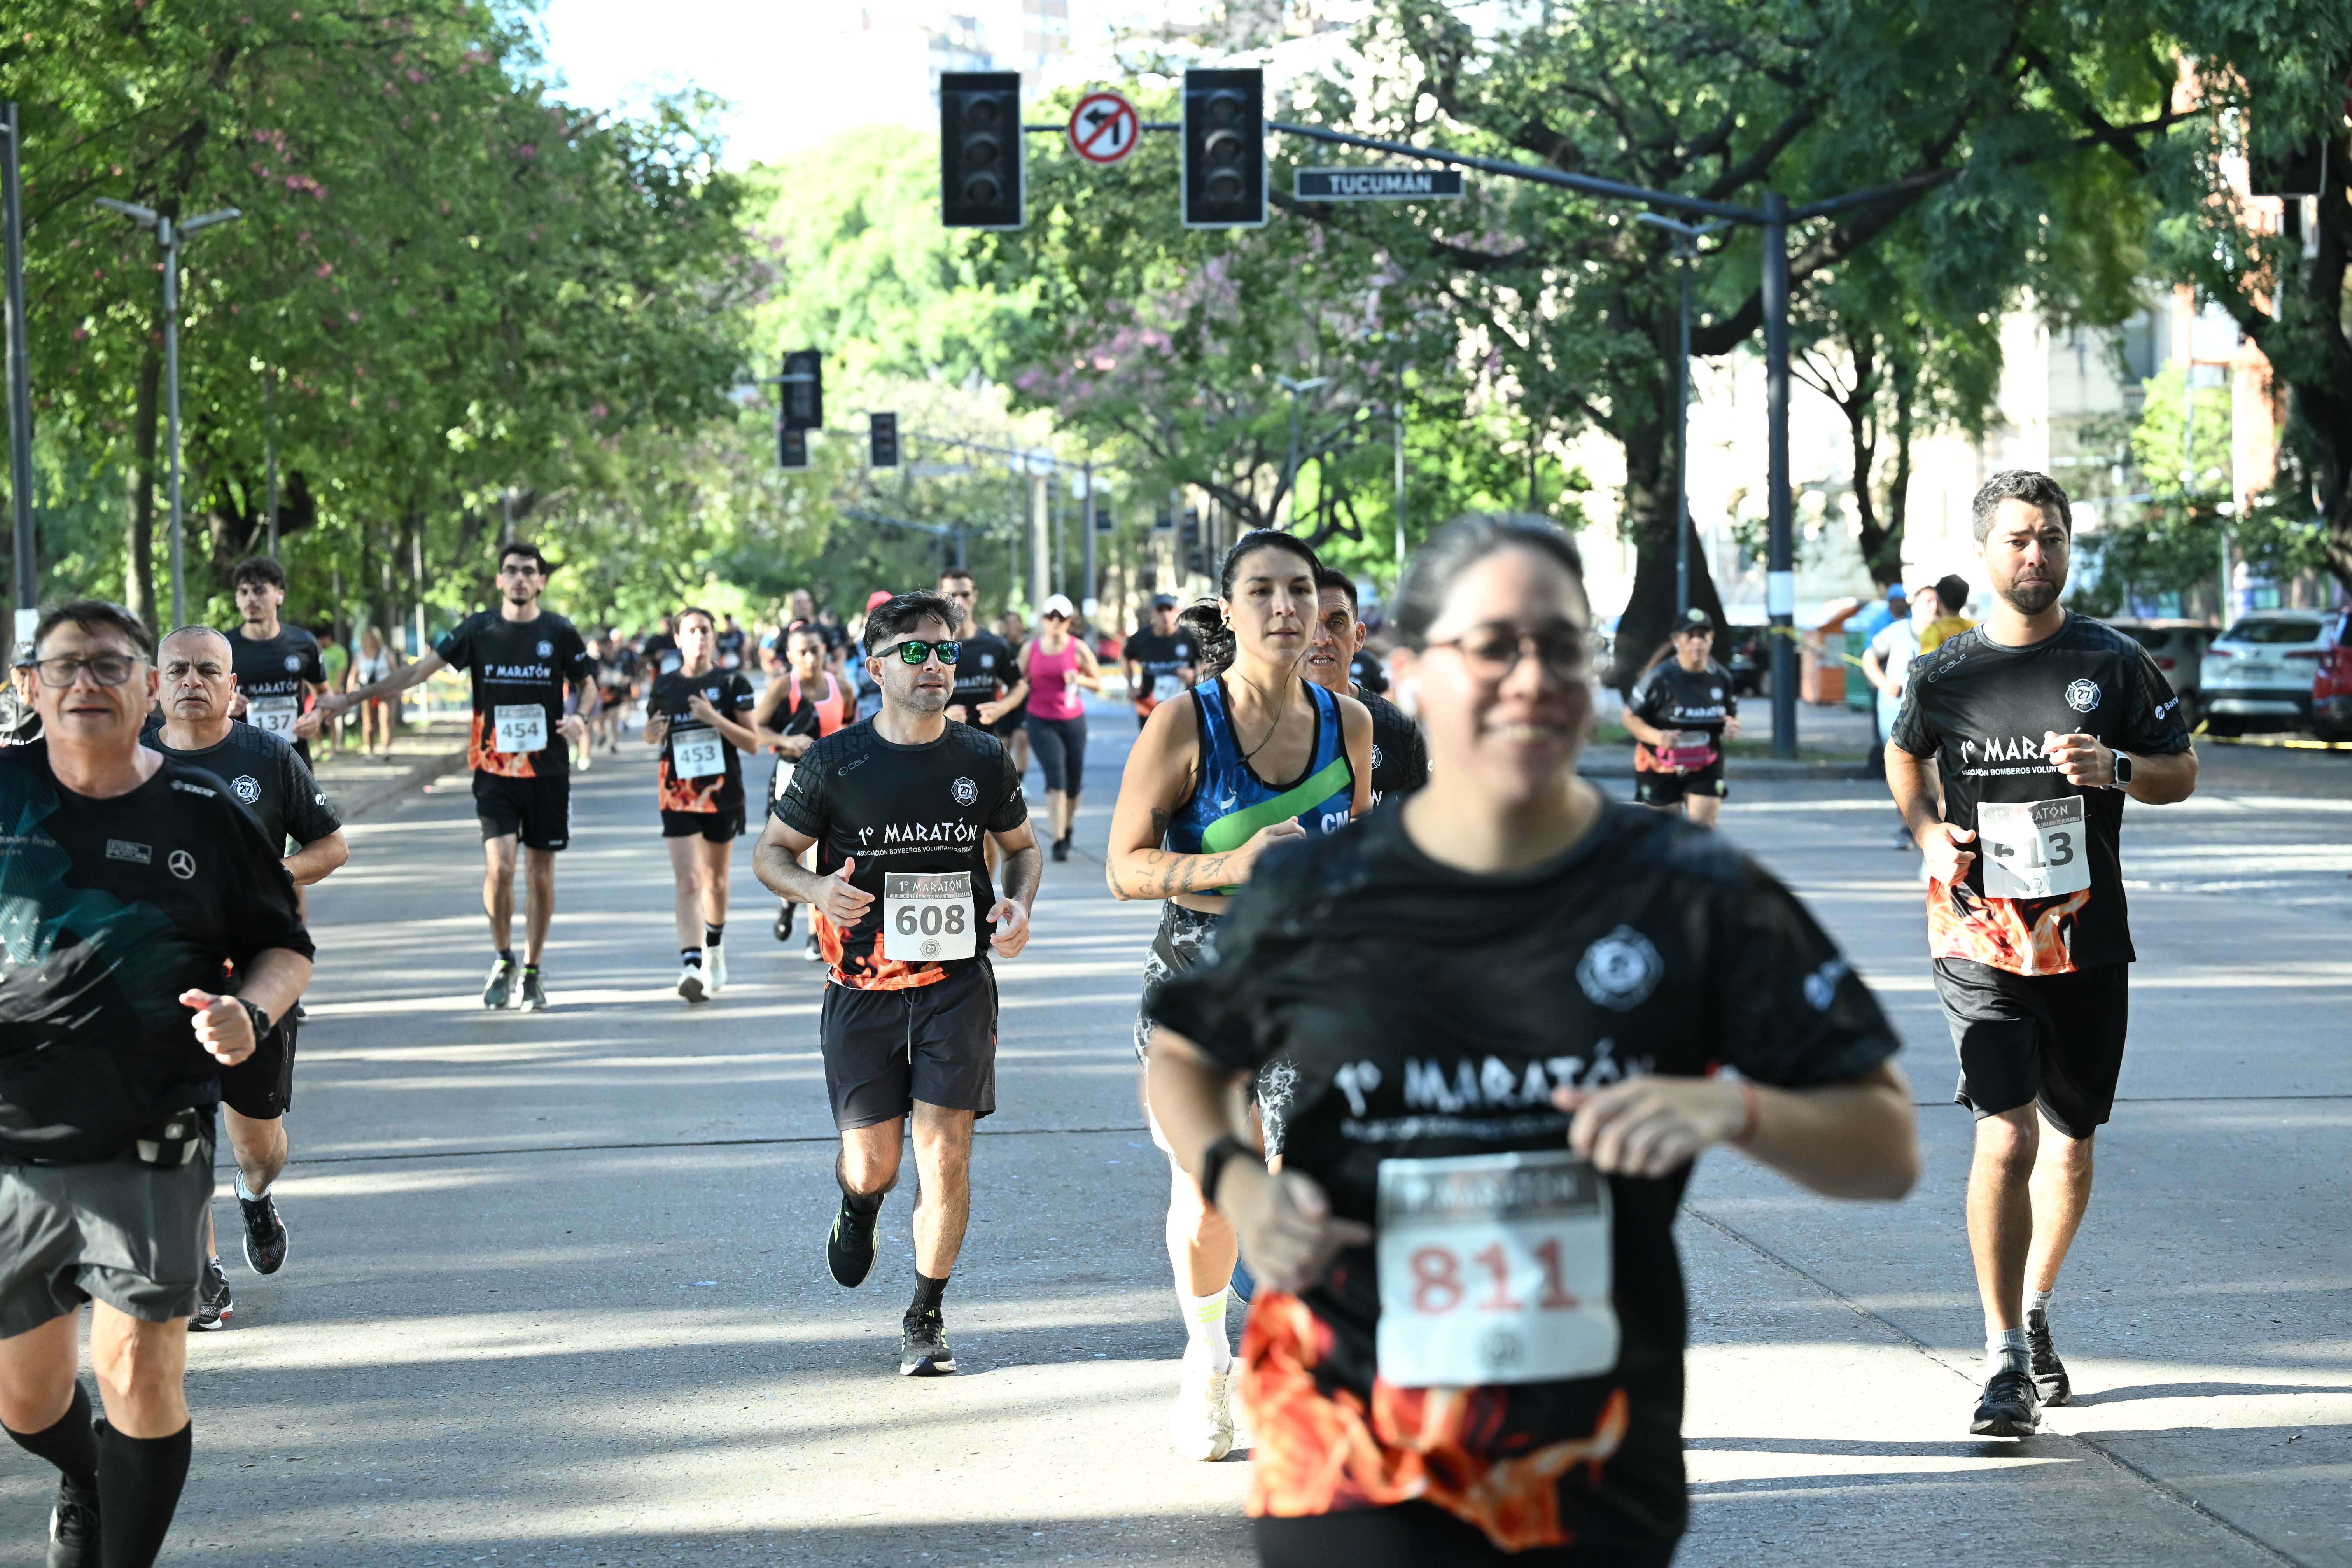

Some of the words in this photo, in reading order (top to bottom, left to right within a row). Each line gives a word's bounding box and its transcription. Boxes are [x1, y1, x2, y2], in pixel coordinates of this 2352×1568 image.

[1329, 172, 1432, 193] TUCUMÁN
[2078, 689, 2090, 700] 27
[255, 714, 290, 730] 137
[502, 722, 538, 738] 454
[681, 746, 716, 763] 453
[1990, 767, 2030, 775] BOMBEROS
[2032, 765, 2060, 774] VOLUNT
[240, 784, 252, 794] 27
[960, 786, 970, 795] 27
[884, 817, 977, 844] MARATÓN
[890, 847, 921, 855] BOMBEROS
[912, 877, 962, 892] MARATÓN
[896, 905, 965, 936] 608
[1409, 1236, 1580, 1317] 811
